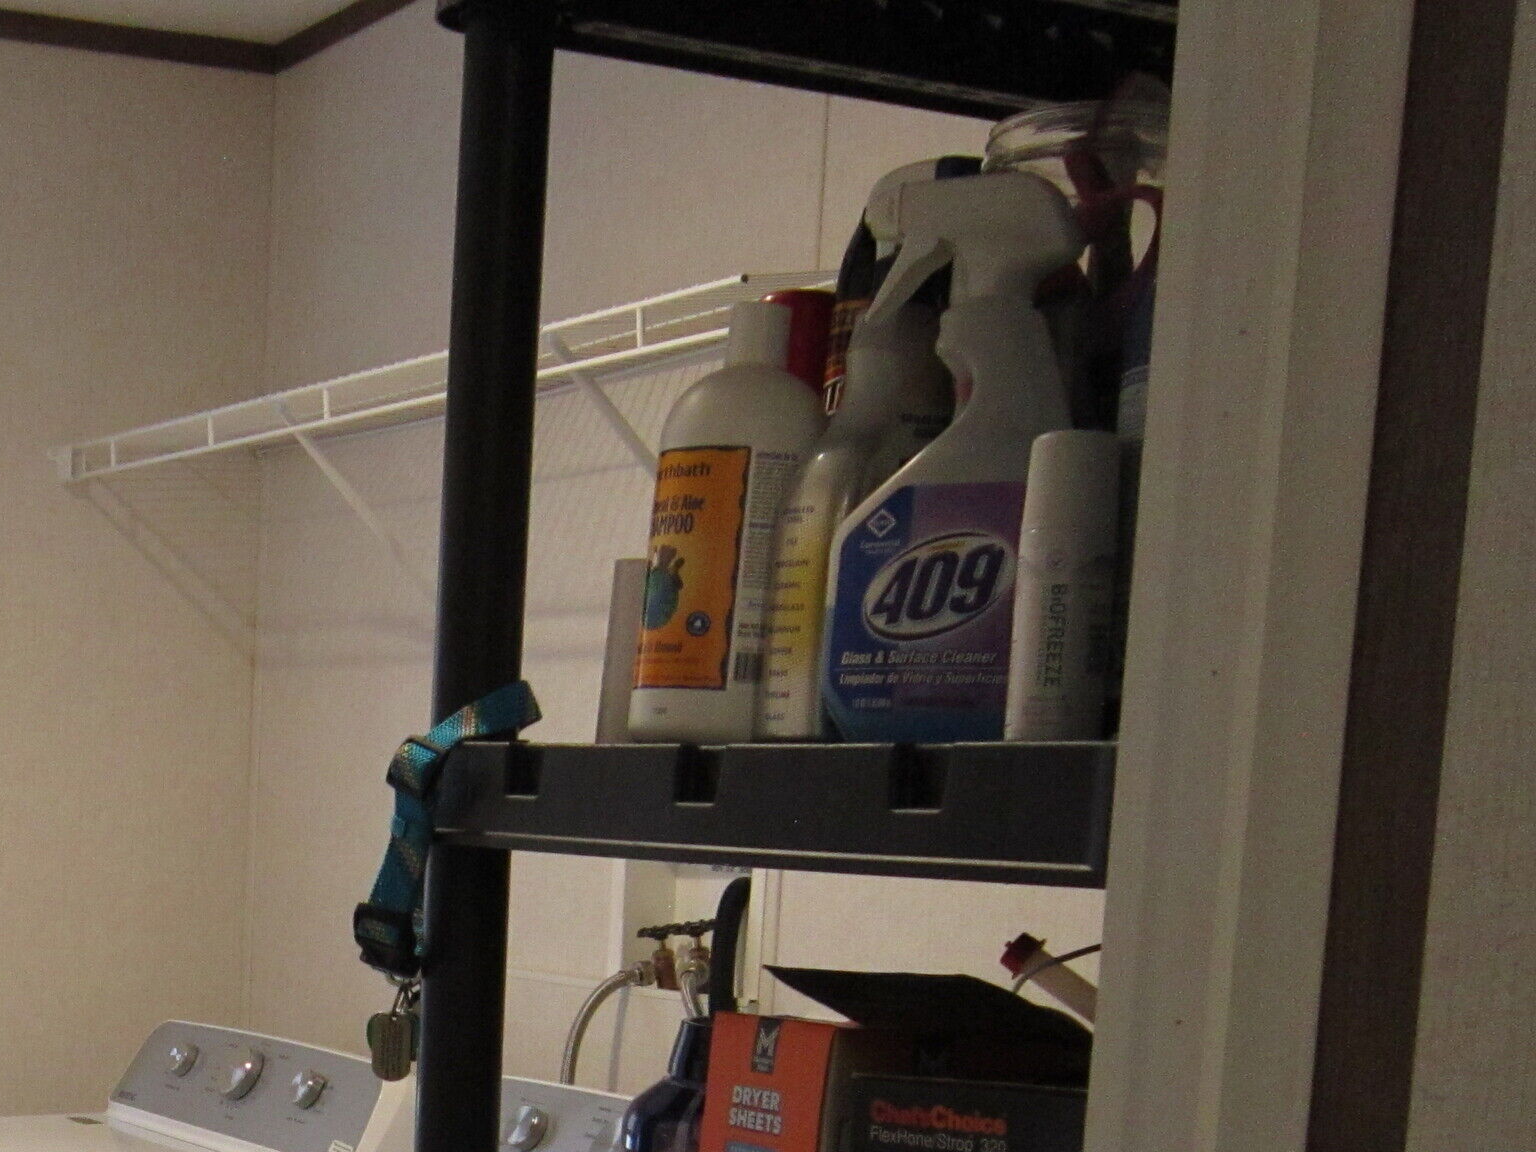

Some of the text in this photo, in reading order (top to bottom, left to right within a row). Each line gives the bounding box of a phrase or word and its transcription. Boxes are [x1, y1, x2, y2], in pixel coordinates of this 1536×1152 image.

[870, 543, 1006, 626] 409
[841, 649, 997, 665] Glass & Surface Cleaner
[731, 1085, 781, 1112] DRYER
[728, 1107, 782, 1136] SHEETS
